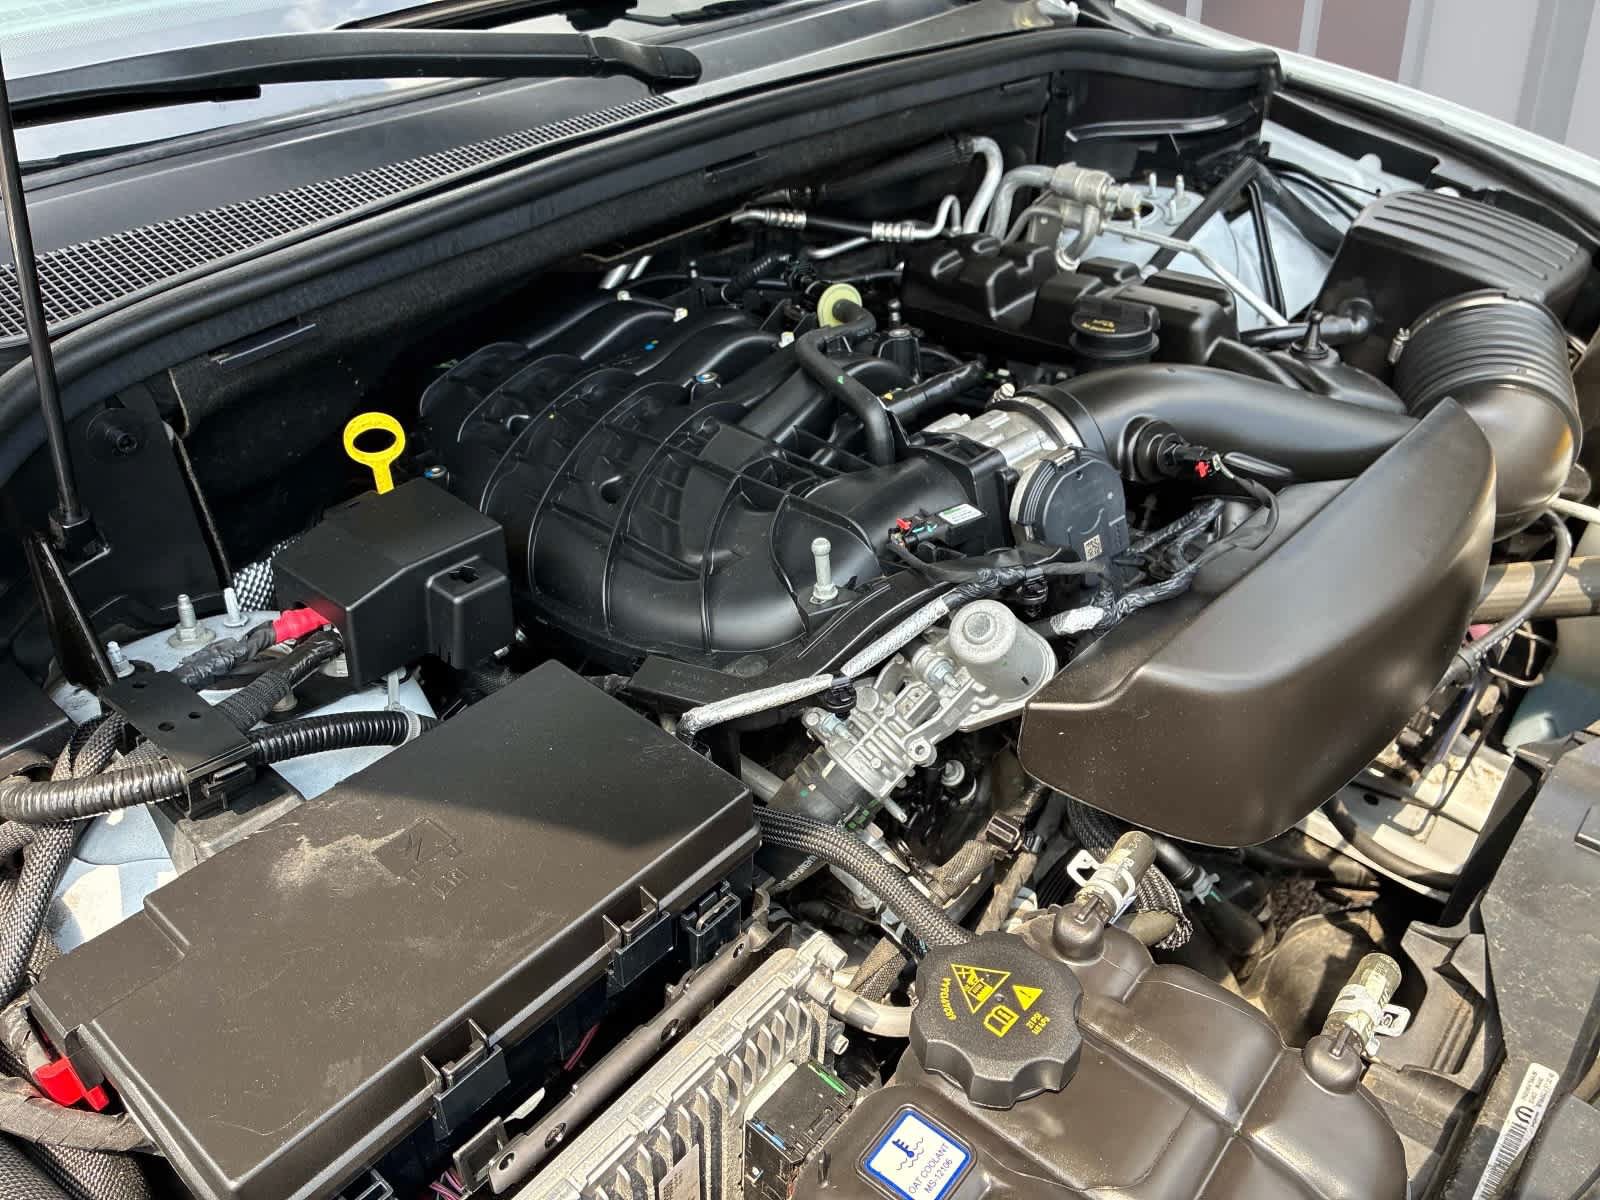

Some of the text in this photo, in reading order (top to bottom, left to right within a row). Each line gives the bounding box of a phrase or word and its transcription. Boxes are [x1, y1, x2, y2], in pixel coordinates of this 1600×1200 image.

[908, 1143, 949, 1194] OAT COOLANT
[924, 1159, 952, 1193] MS-12106
